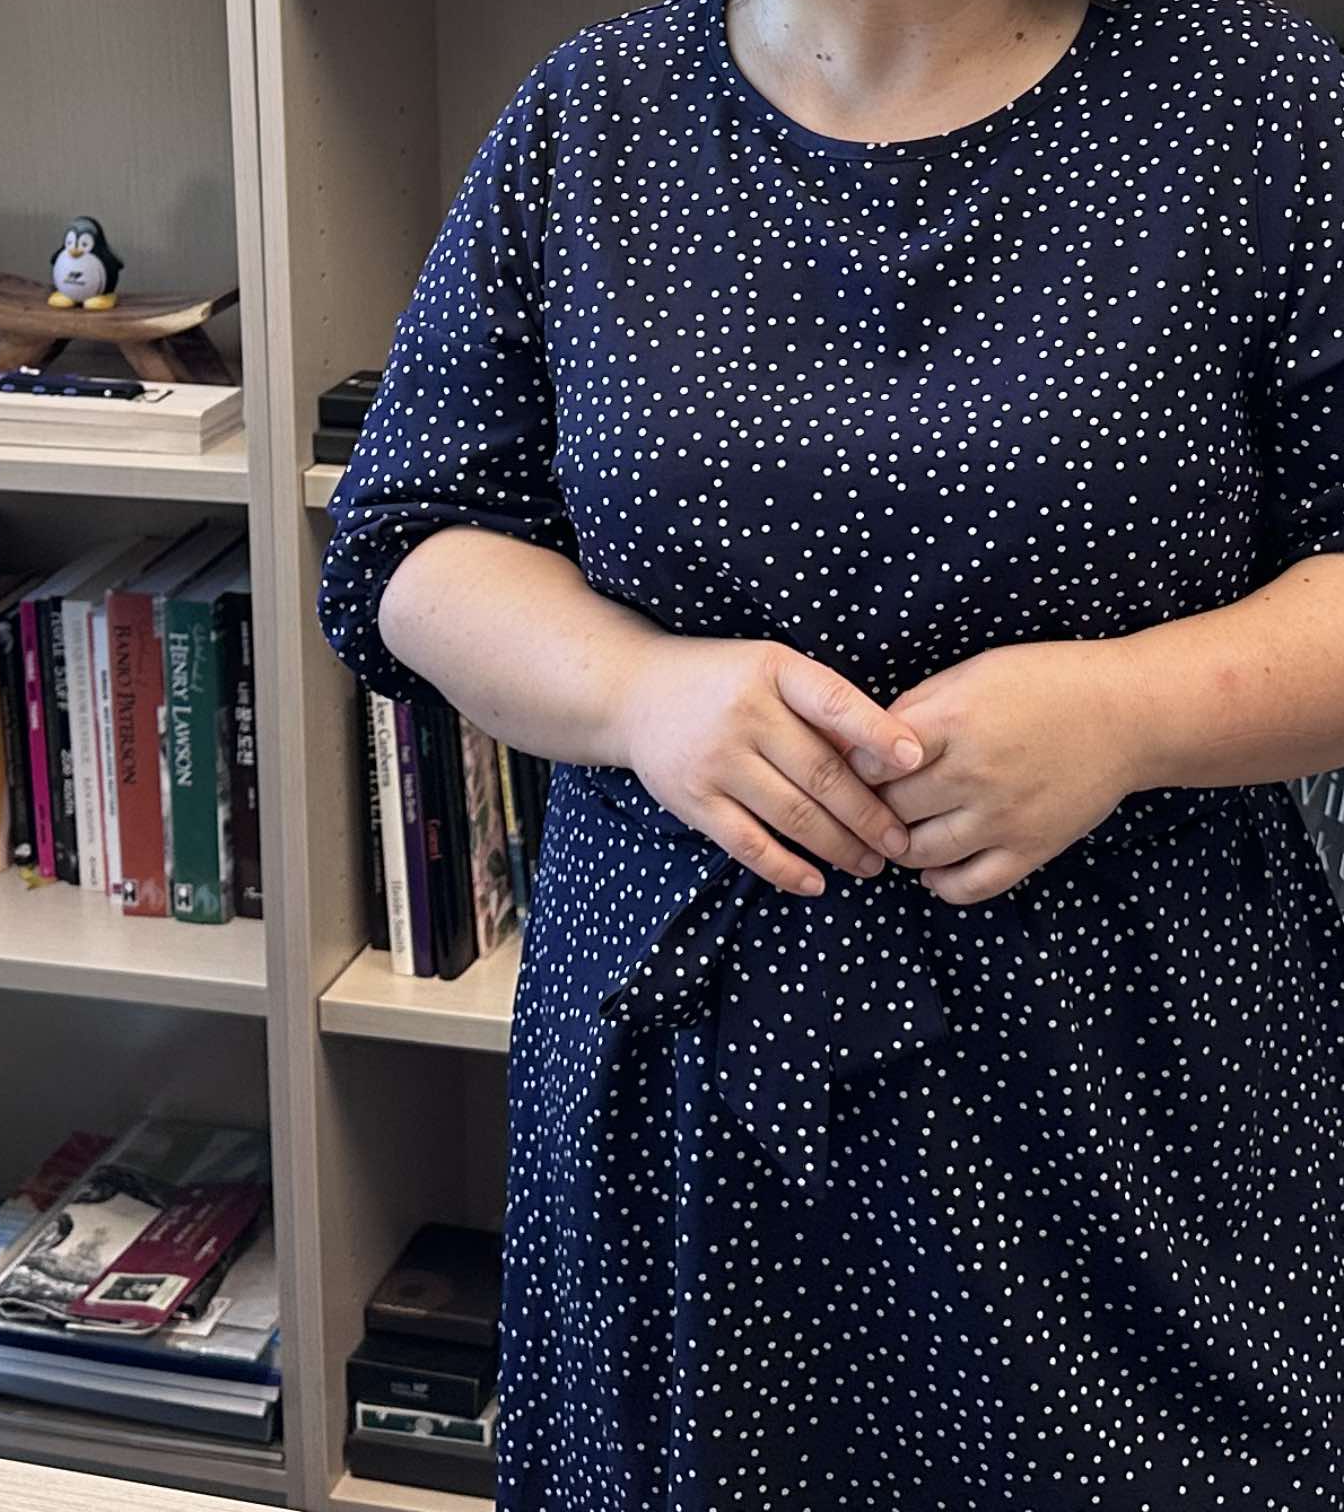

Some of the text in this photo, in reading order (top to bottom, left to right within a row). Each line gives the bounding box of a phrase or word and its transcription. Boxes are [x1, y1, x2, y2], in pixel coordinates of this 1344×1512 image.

[113, 625, 137, 785] BANJO PATERSON
[169, 632, 193, 787] HENRY LAWSON
